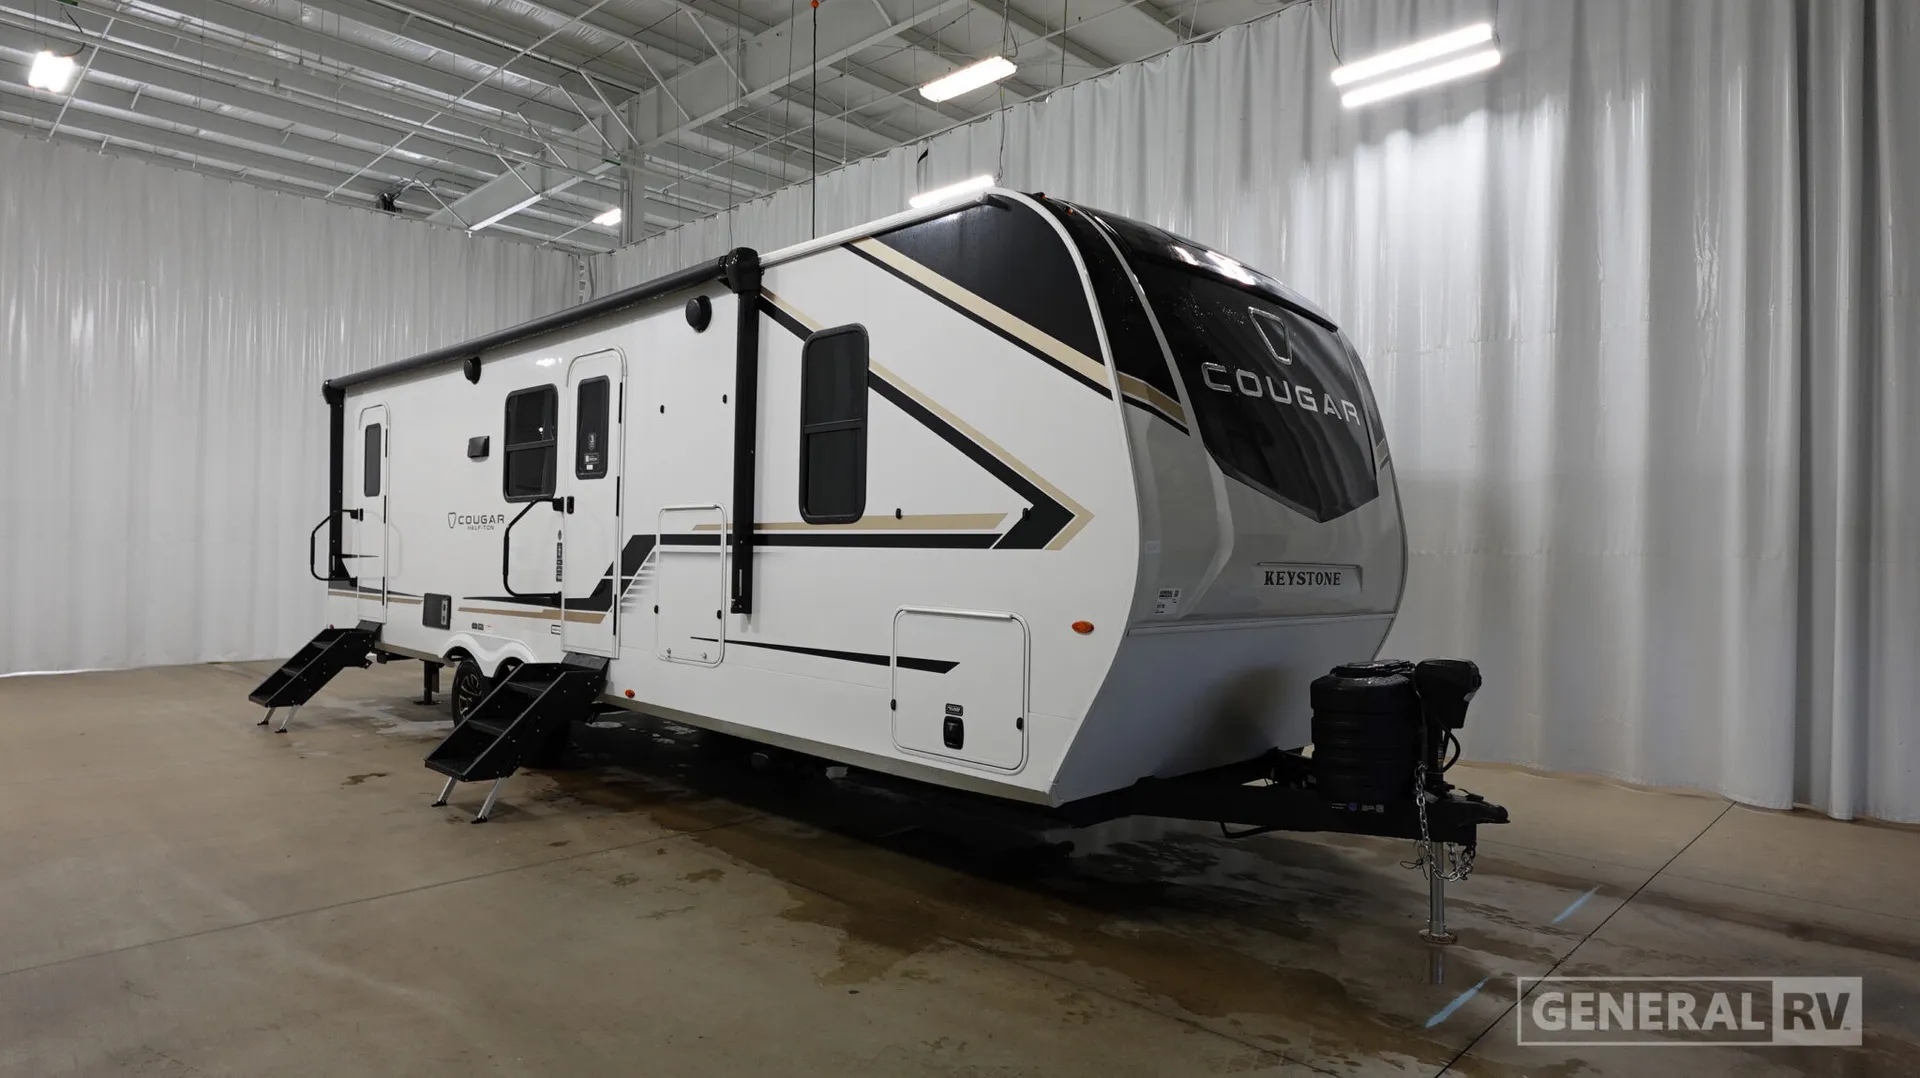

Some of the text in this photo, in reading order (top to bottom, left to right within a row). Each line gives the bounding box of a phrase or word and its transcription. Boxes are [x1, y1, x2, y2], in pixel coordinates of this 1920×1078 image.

[1201, 361, 1361, 426] COUGAR
[458, 514, 505, 525] COUGAR
[1263, 570, 1342, 586] KEYSTONE
